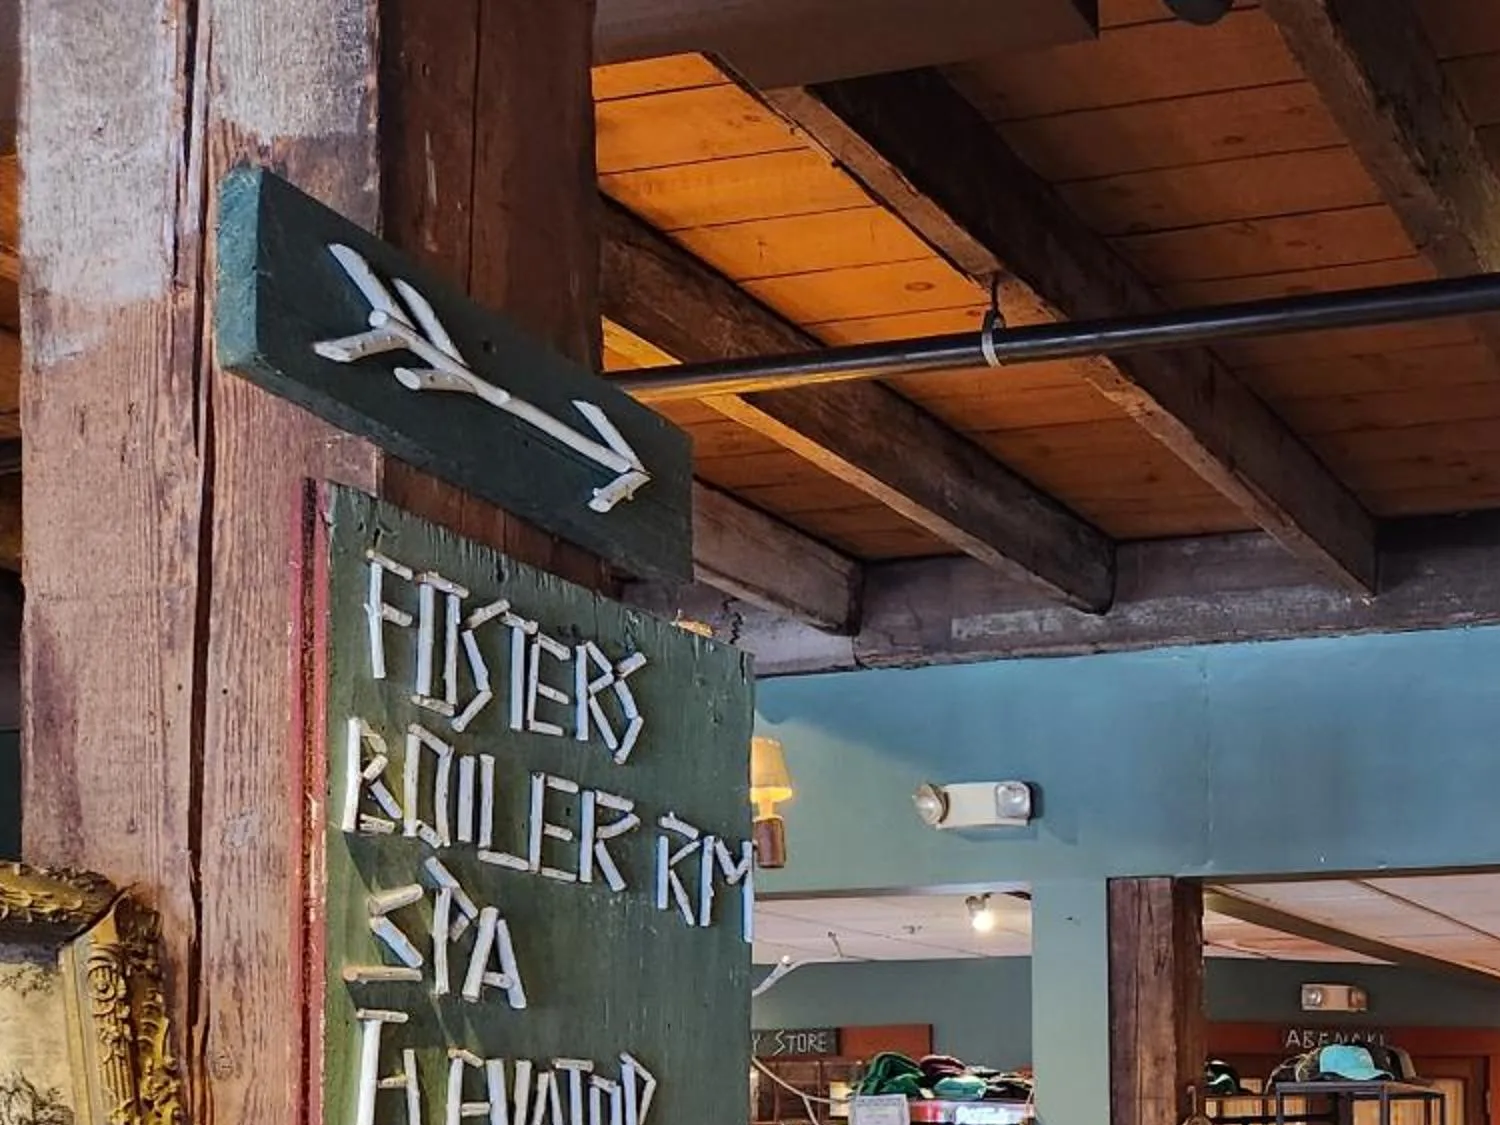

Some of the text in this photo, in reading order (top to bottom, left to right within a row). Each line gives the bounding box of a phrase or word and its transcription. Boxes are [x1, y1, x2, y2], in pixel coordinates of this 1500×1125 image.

[363, 548, 648, 765] FOSTERS
[341, 716, 753, 943] BOILER RM
[342, 856, 526, 1009] SPA
[773, 1030, 828, 1056] STORE
